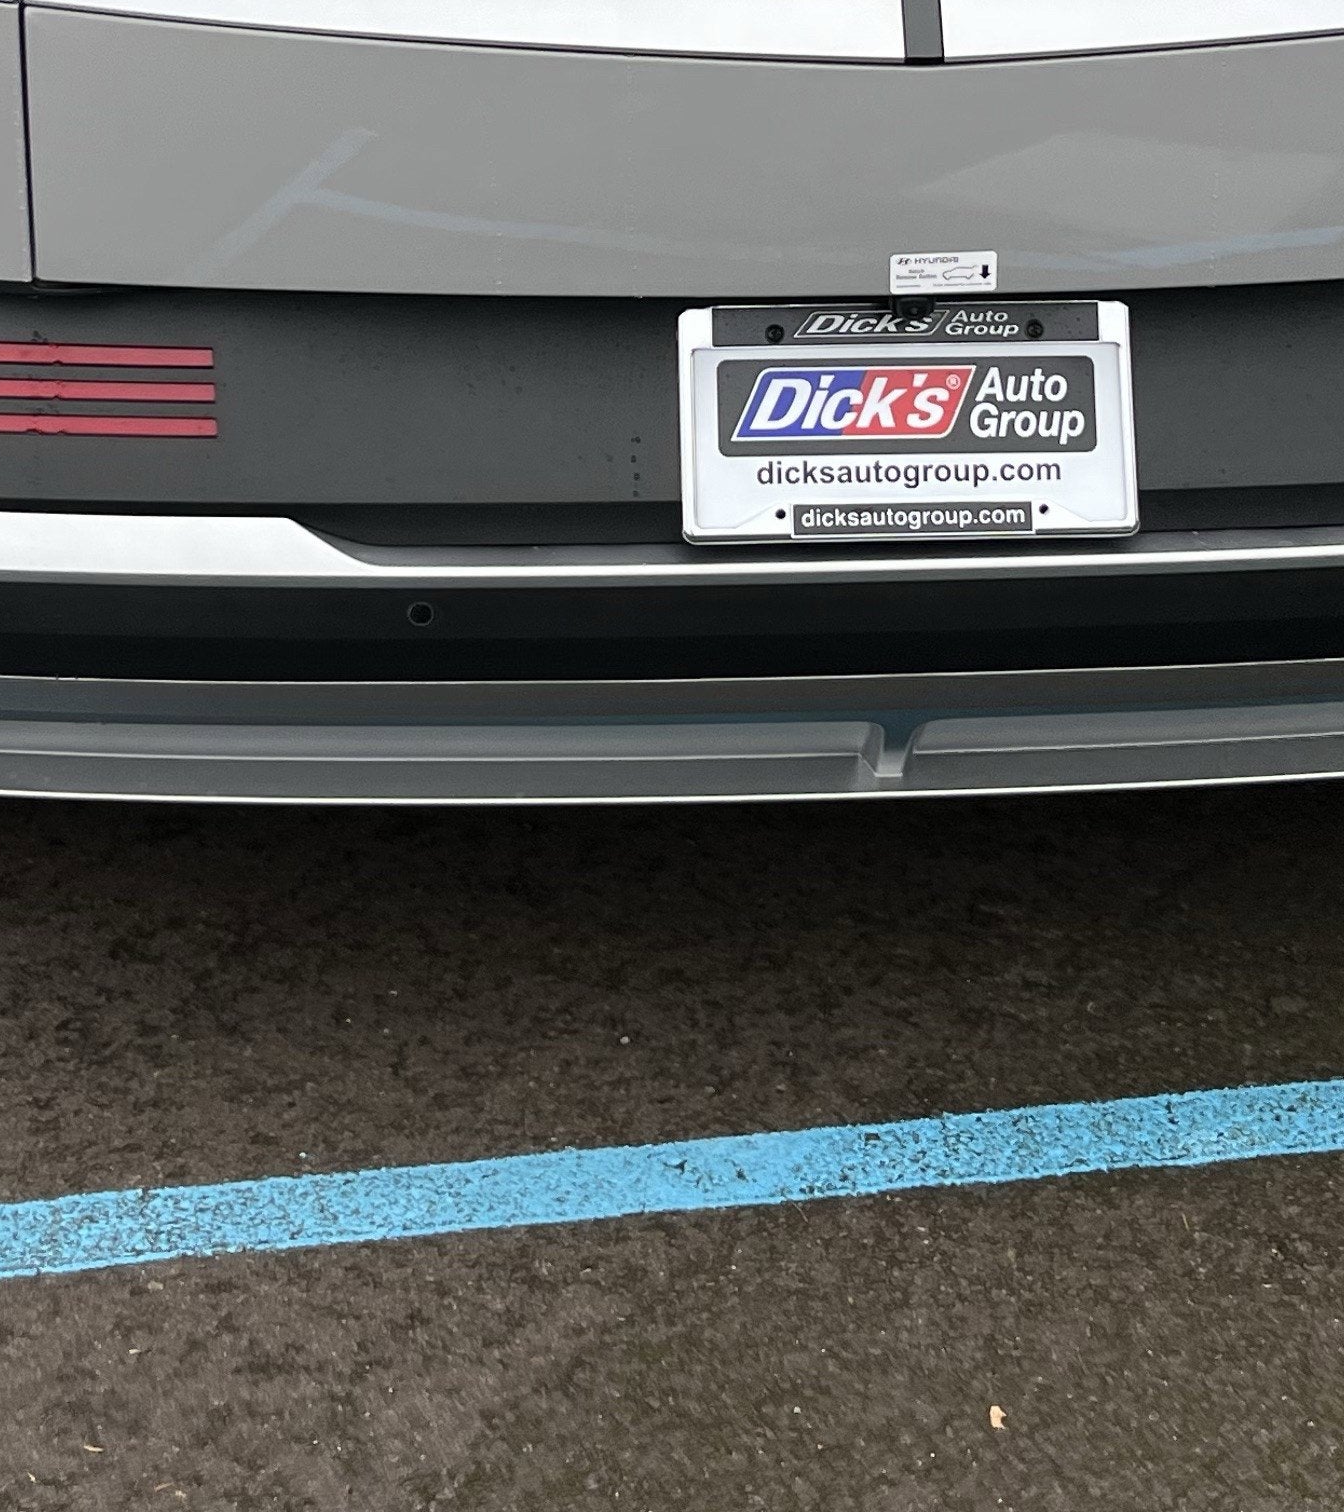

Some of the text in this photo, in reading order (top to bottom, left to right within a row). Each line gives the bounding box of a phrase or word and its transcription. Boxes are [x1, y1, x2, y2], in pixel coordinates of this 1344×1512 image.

[806, 313, 933, 334] Dicks
[952, 309, 1009, 323] Auto
[945, 322, 1020, 338] Group
[974, 366, 1068, 402] Auto
[749, 372, 951, 431] Dick's
[969, 402, 1086, 445] Group
[756, 460, 1062, 488] dicksautogroup.com
[801, 506, 1026, 530] dicksautogroup.com
